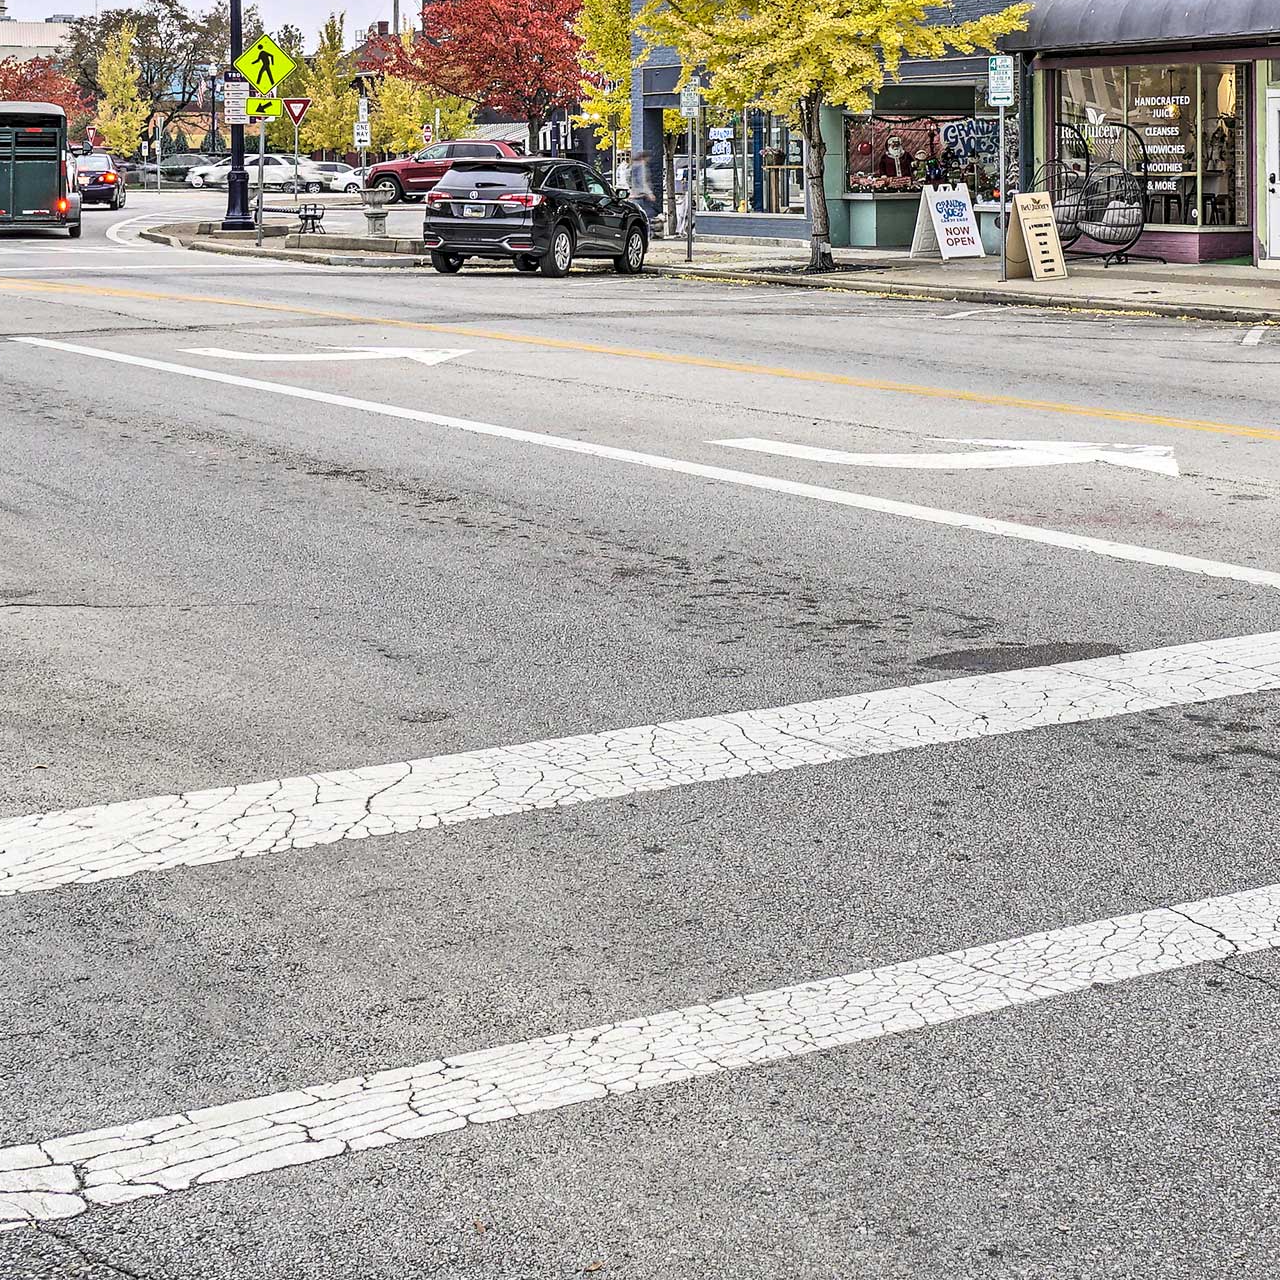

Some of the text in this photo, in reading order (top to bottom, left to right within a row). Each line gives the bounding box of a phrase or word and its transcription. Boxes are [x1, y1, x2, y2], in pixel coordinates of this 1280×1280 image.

[1134, 96, 1190, 106] HANDCRAFTED
[1145, 127, 1179, 136] CLEANSES
[1147, 181, 1177, 190] & MORE
[935, 200, 967, 214] GRANDPA
[945, 226, 970, 236] NOW
[946, 237, 975, 247] OPEN
